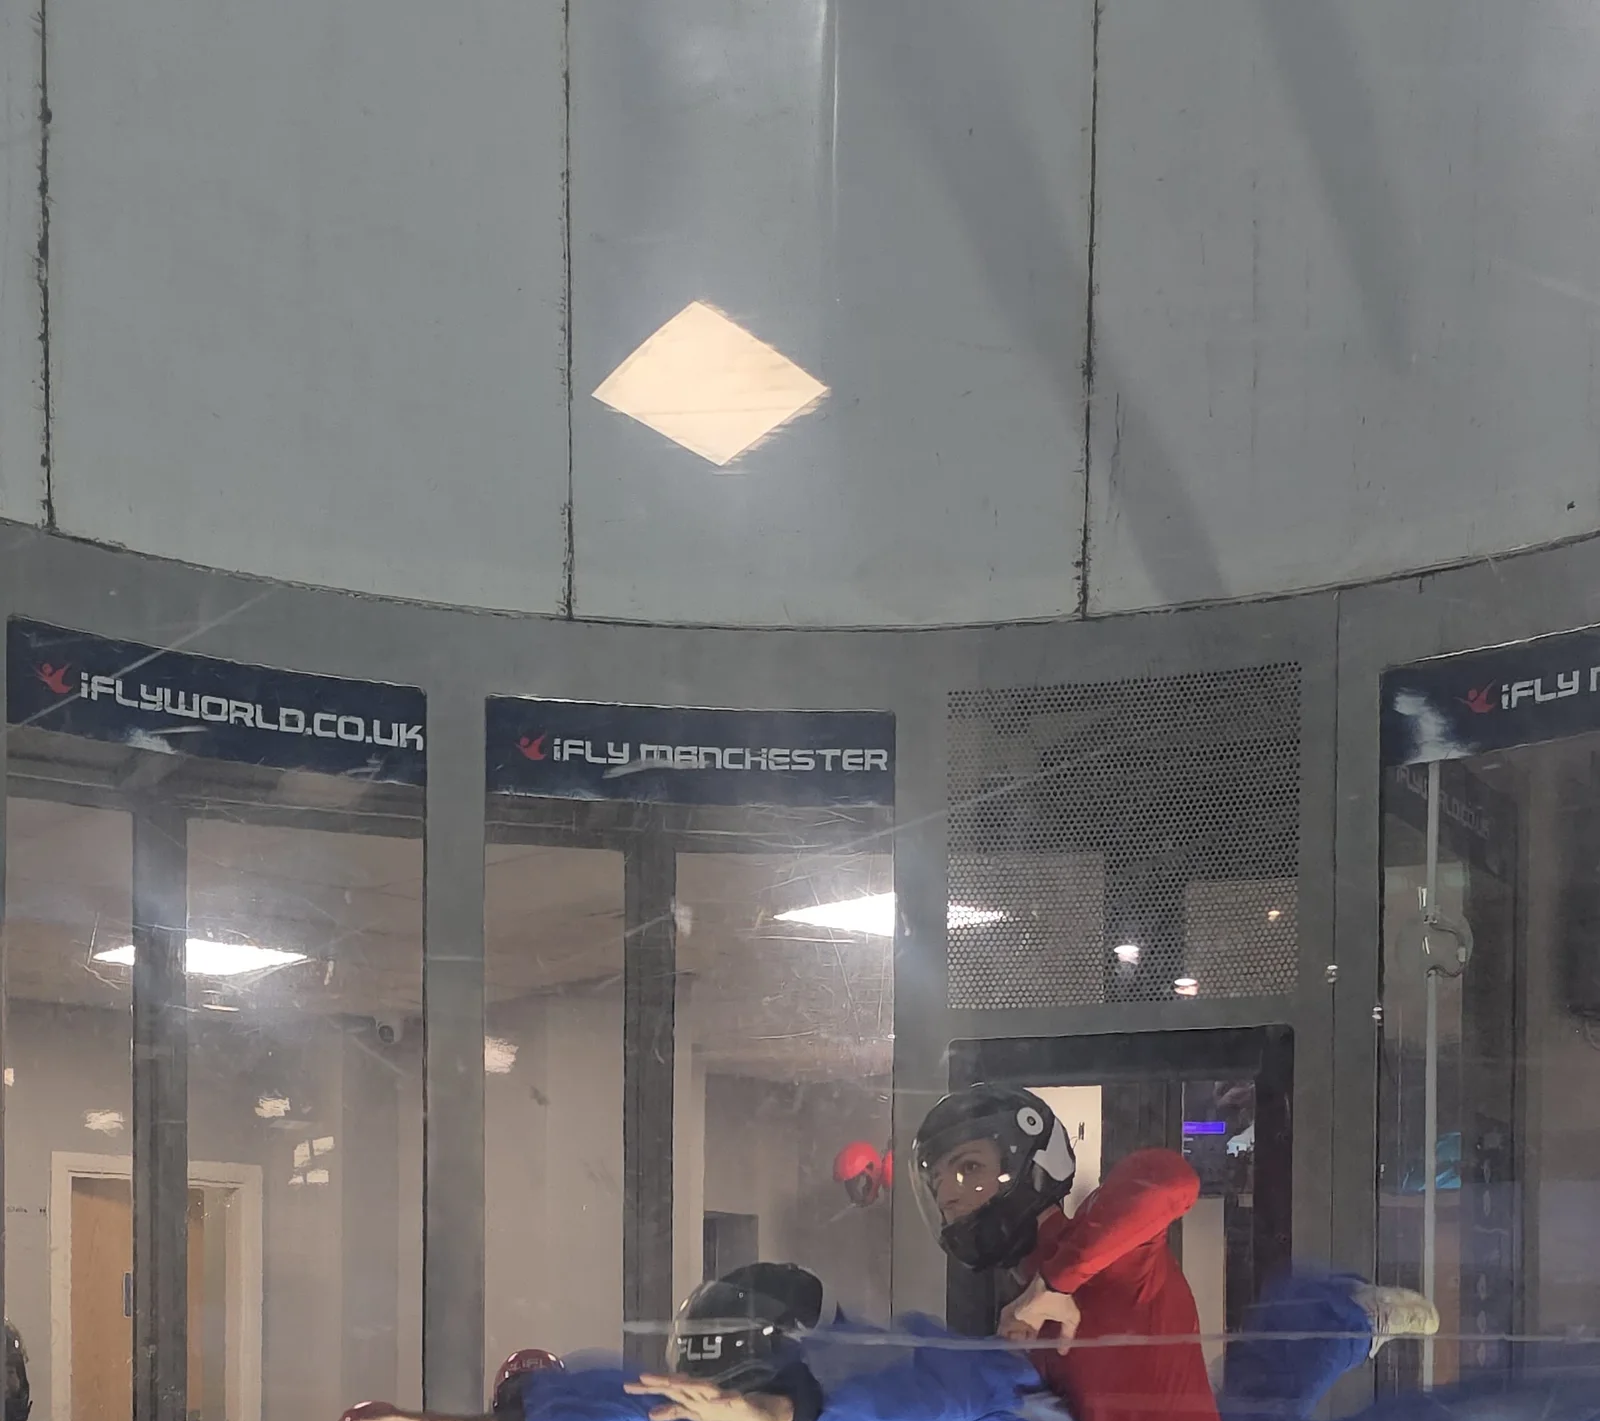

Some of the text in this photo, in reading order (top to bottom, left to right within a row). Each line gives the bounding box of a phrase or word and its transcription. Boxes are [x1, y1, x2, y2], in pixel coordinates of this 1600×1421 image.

[1502, 670, 1580, 710] iFLY
[80, 672, 424, 751] iFLYWORLD.CO.UK
[553, 737, 889, 772] iFLY MANCHESTER
